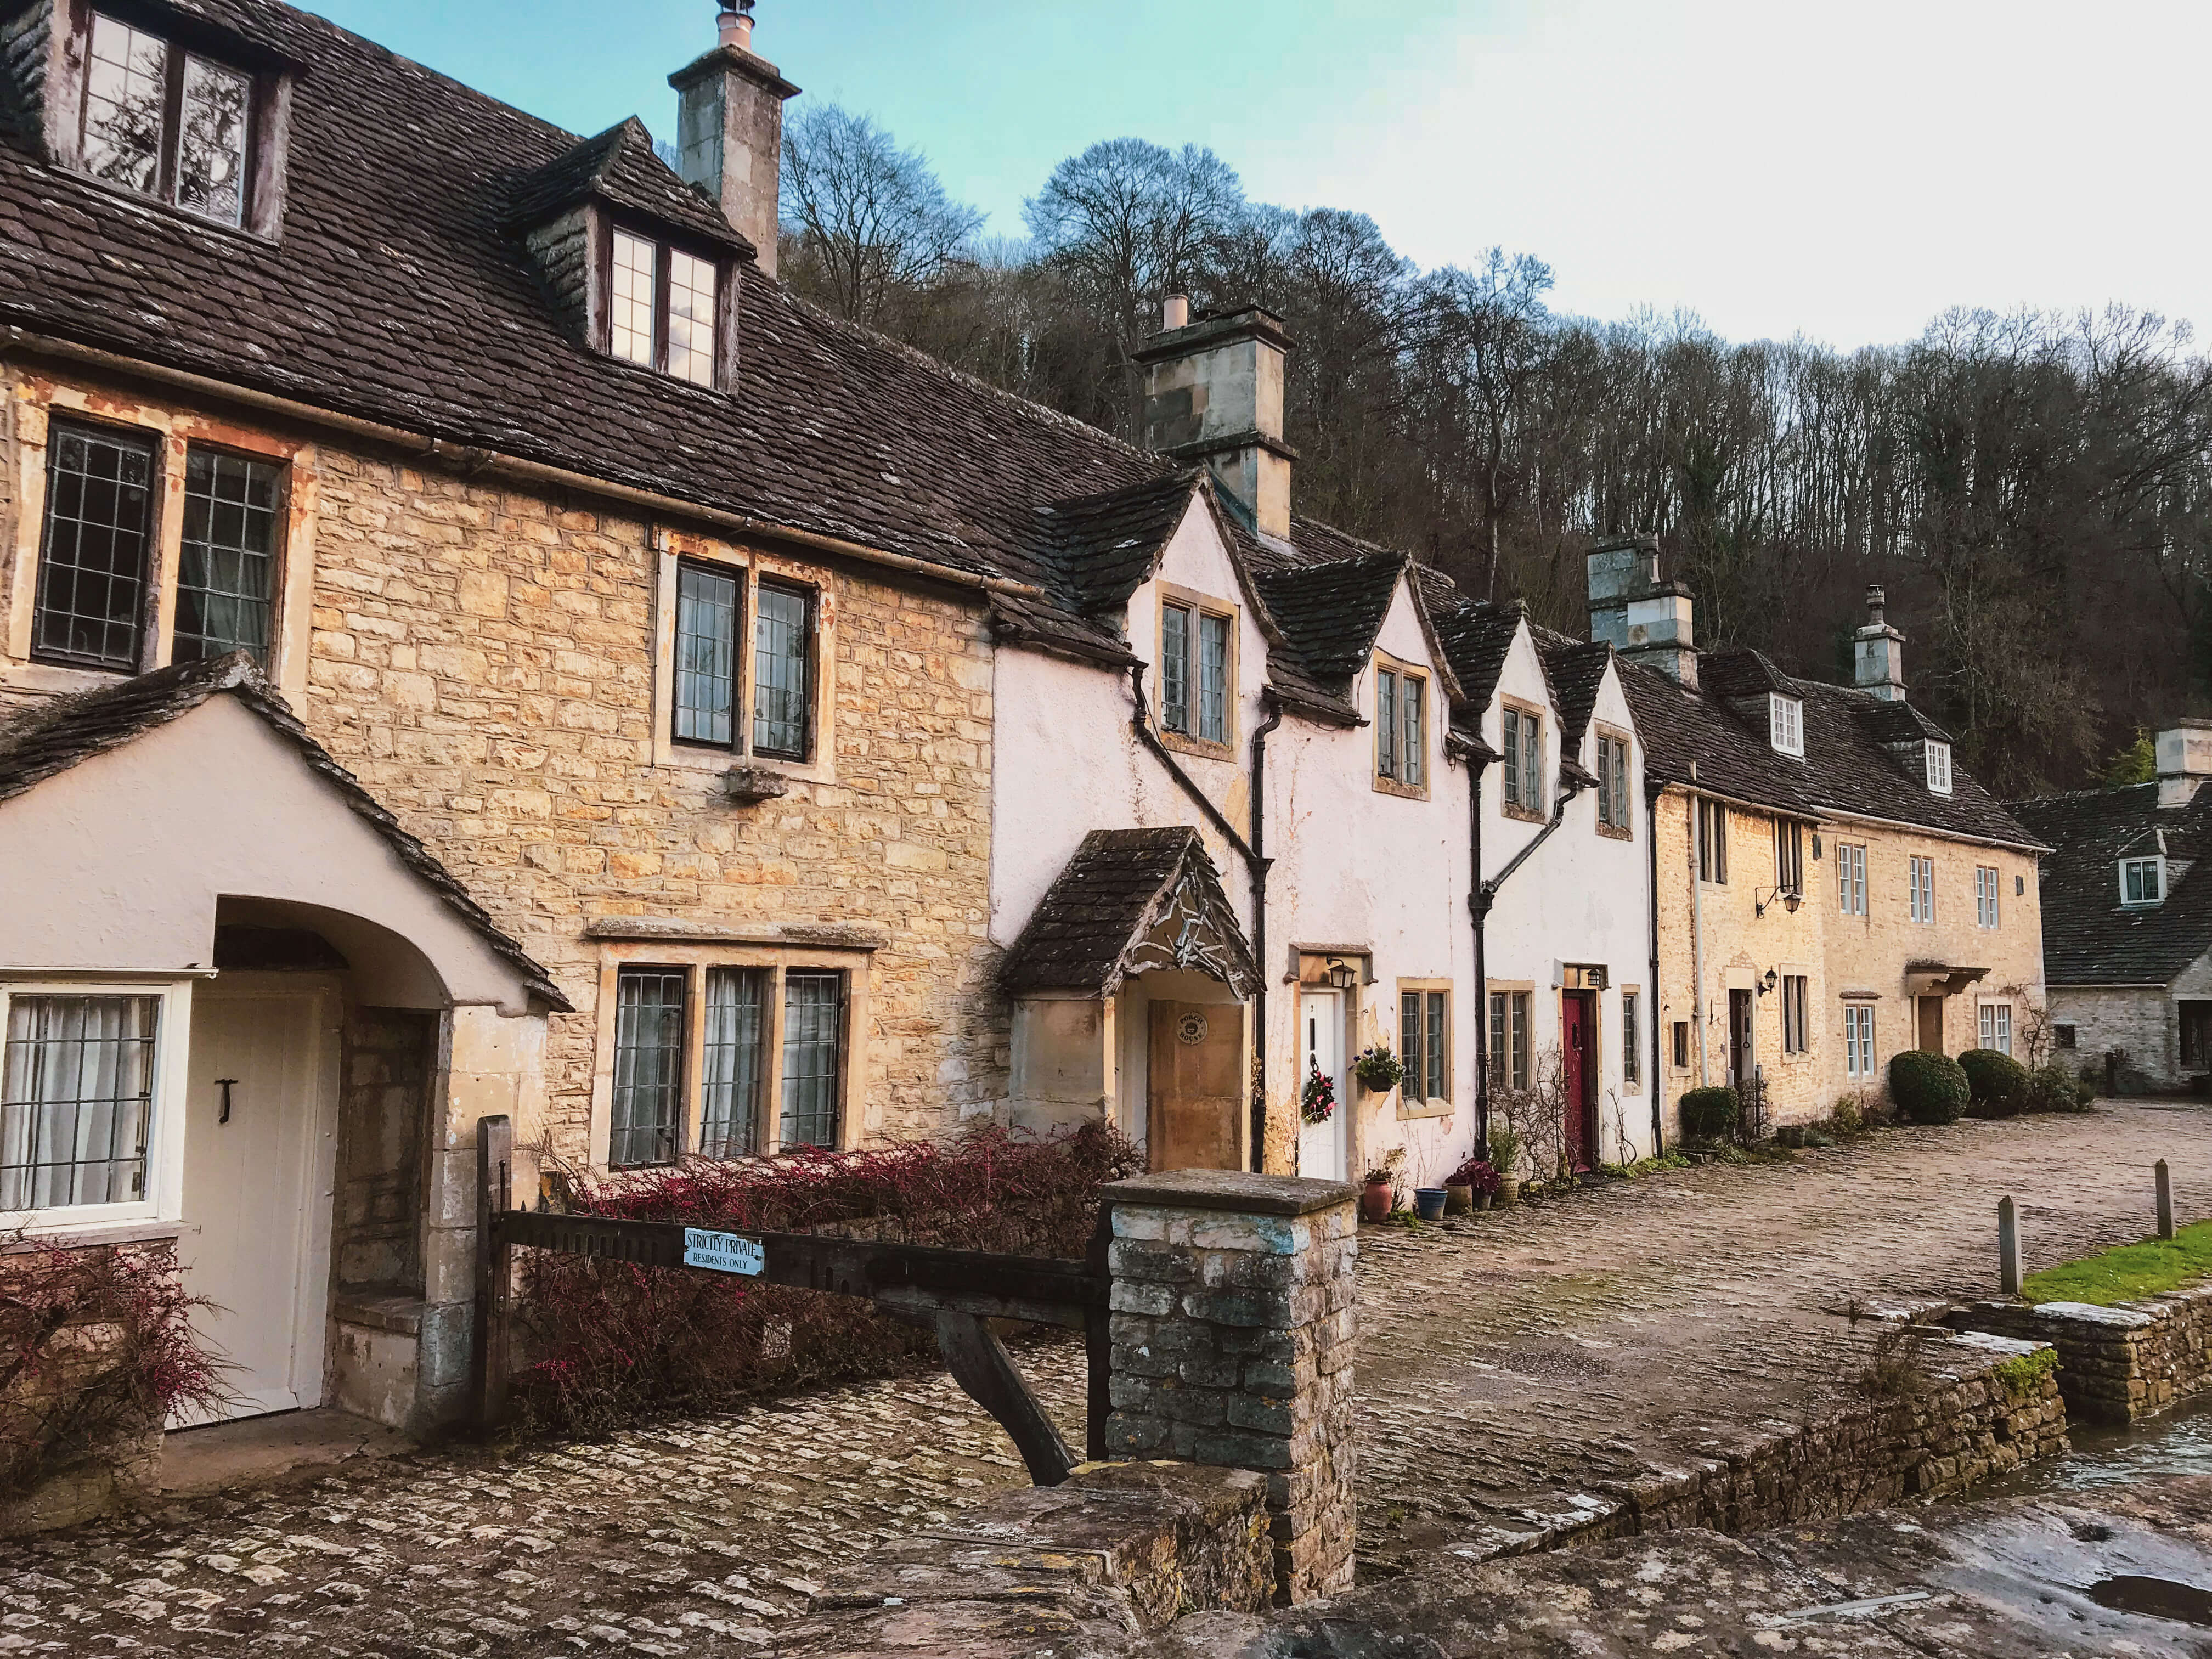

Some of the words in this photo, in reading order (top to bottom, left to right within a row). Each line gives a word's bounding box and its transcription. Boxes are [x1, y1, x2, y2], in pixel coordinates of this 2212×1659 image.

[1180, 1015, 1203, 1024] PORCH
[687, 1233, 723, 1251] STRICTLY
[725, 1238, 755, 1256] PRIVATE
[693, 1252, 726, 1266] RESIDENTS
[729, 1259, 748, 1269] ONLY
